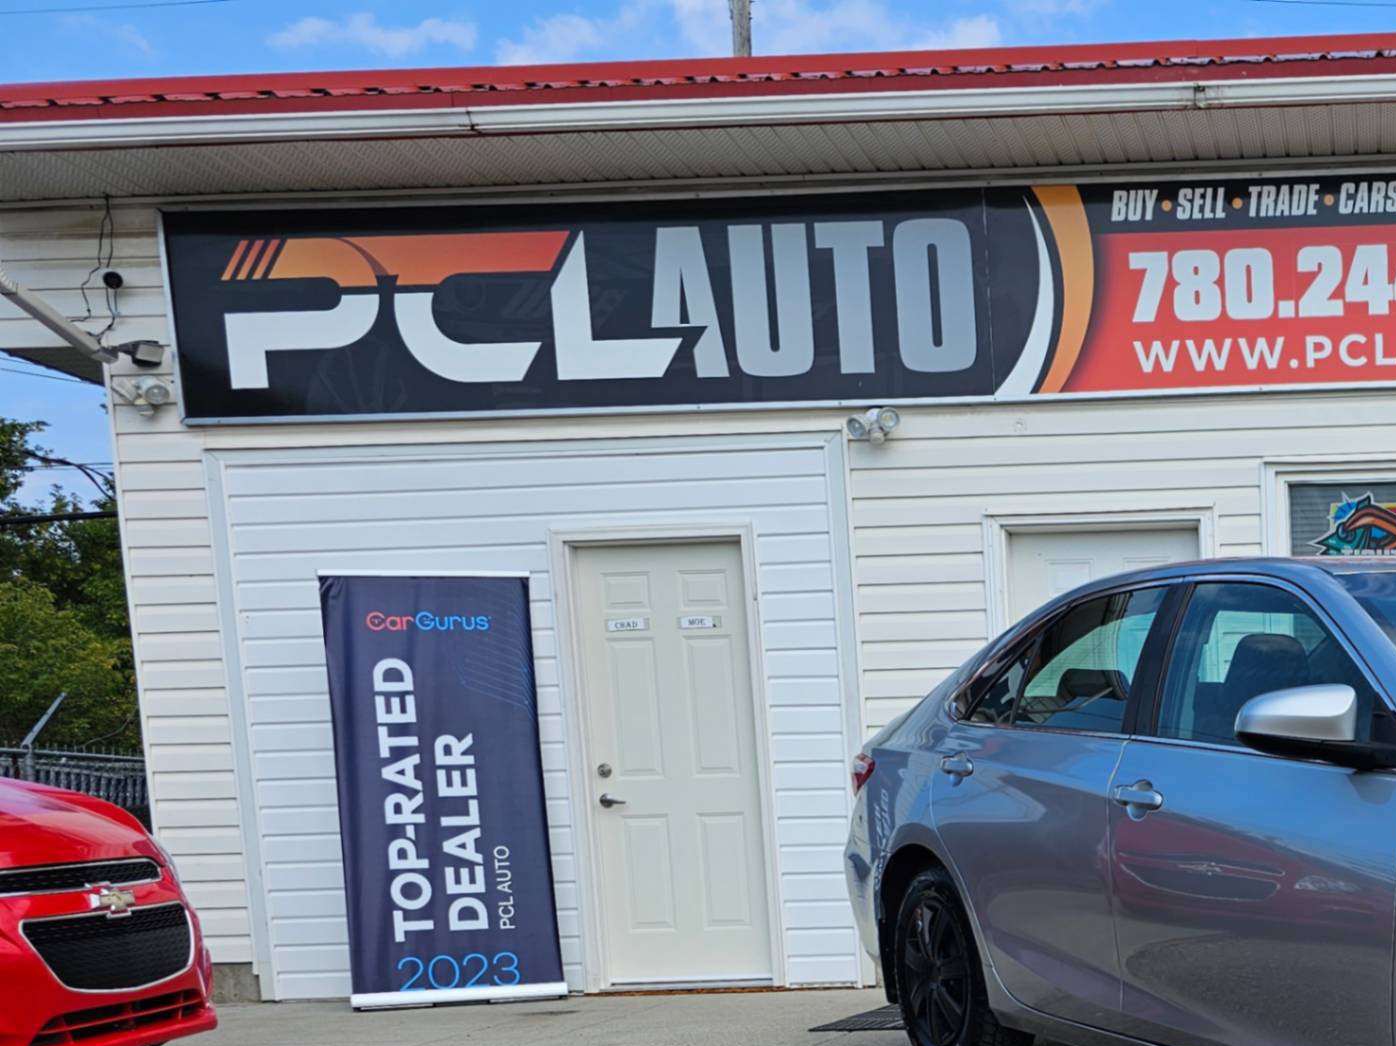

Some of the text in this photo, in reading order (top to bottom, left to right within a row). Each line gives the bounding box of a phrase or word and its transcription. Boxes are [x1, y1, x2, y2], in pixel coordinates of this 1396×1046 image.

[1110, 189, 1160, 222] BUY
[1176, 187, 1227, 219] SELL
[1248, 184, 1321, 217] TRADE
[651, 217, 977, 379] AUTO
[366, 611, 490, 631] CarGurus
[373, 657, 434, 942] TOP-RATED
[435, 733, 489, 931] DEALER
[493, 845, 517, 931] PCL AUTO
[397, 951, 521, 992] 2023
